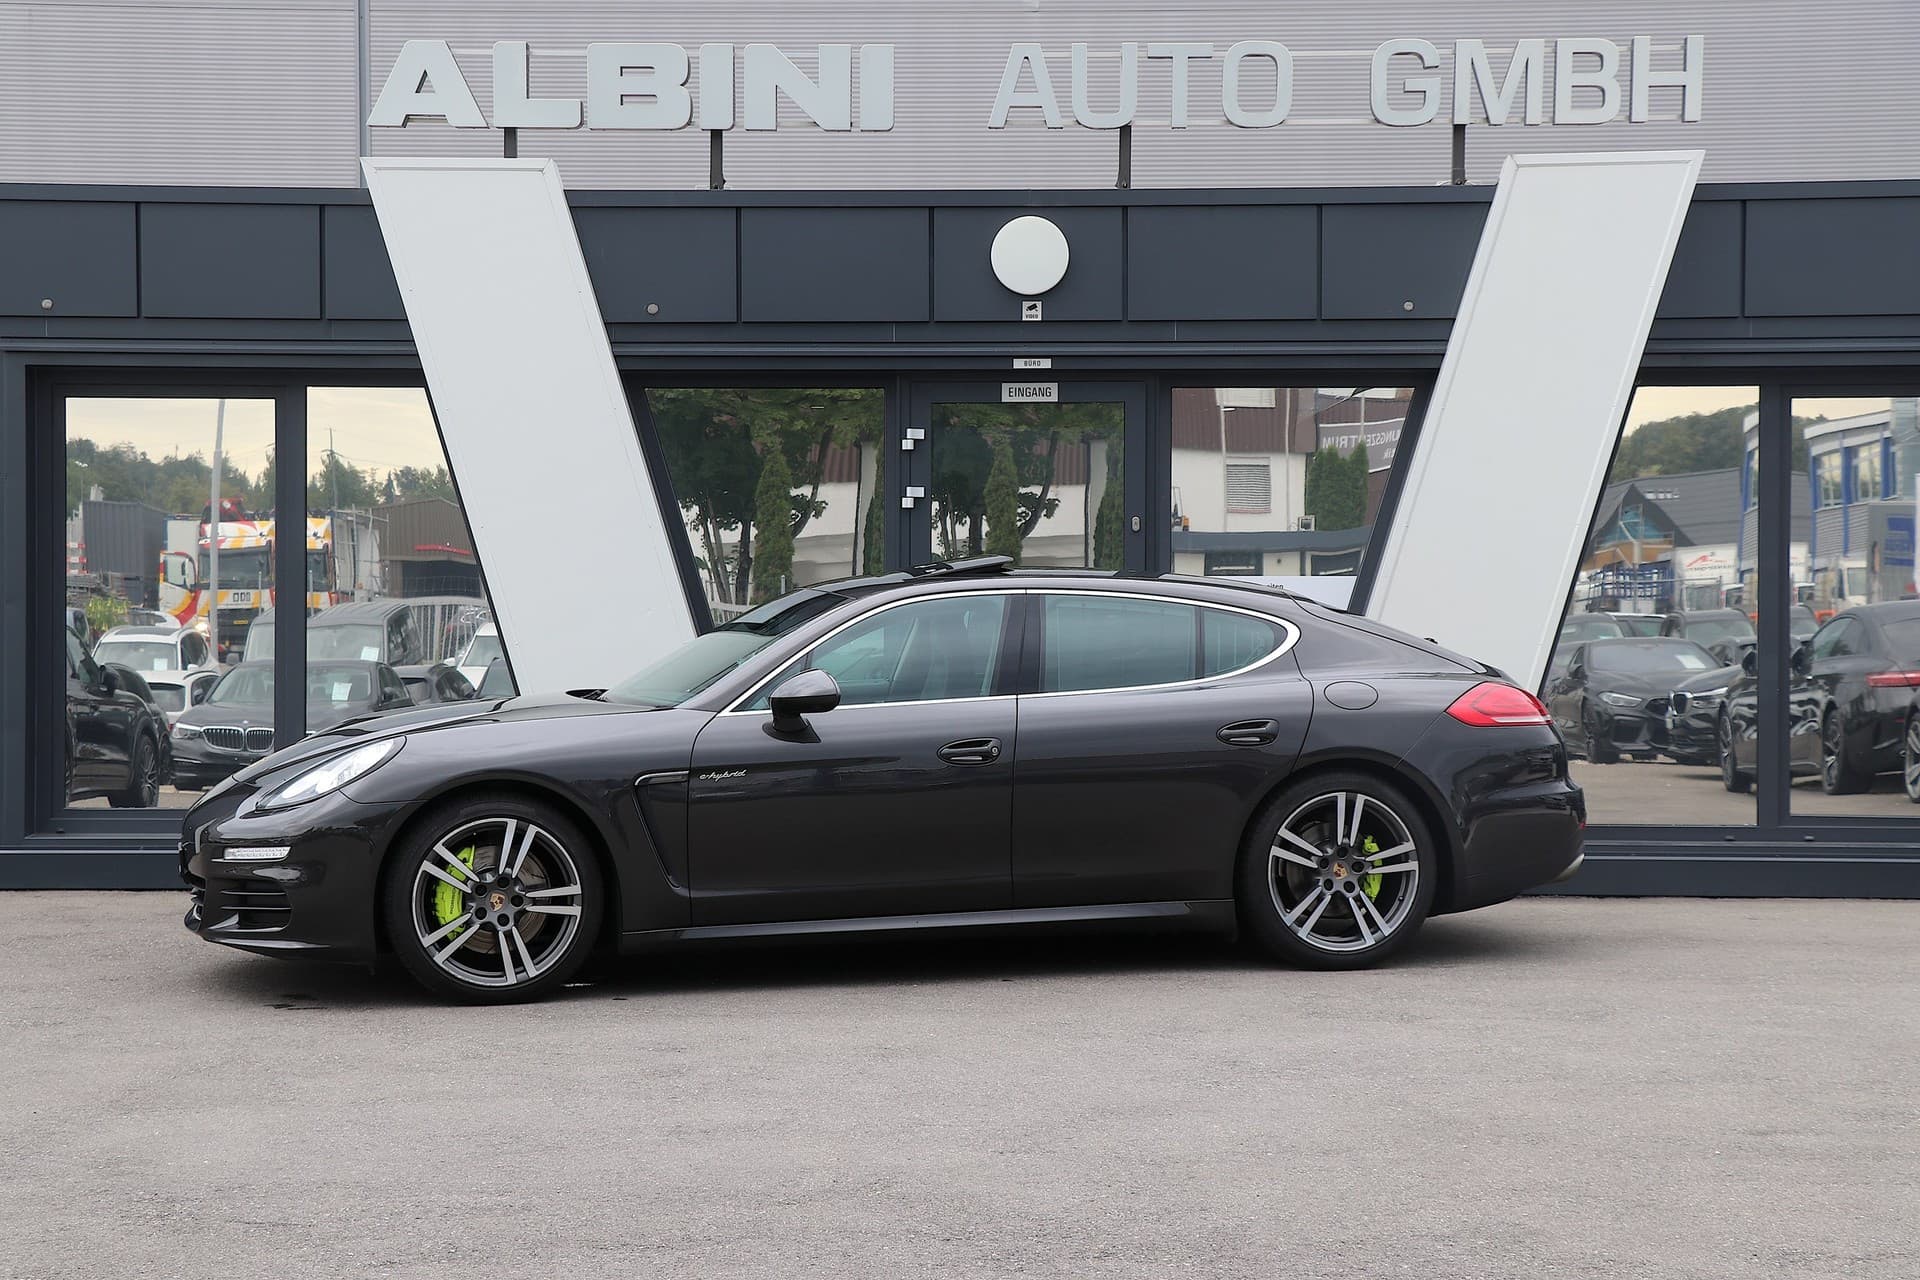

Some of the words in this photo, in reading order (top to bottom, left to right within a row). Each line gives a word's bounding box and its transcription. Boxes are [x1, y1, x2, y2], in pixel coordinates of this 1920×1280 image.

[366, 40, 896, 131] ALBINI
[987, 40, 1294, 130] AUTO
[1370, 35, 1705, 128] GMBH
[1023, 359, 1042, 367] BÜRO
[1008, 386, 1052, 398] EINGANG
